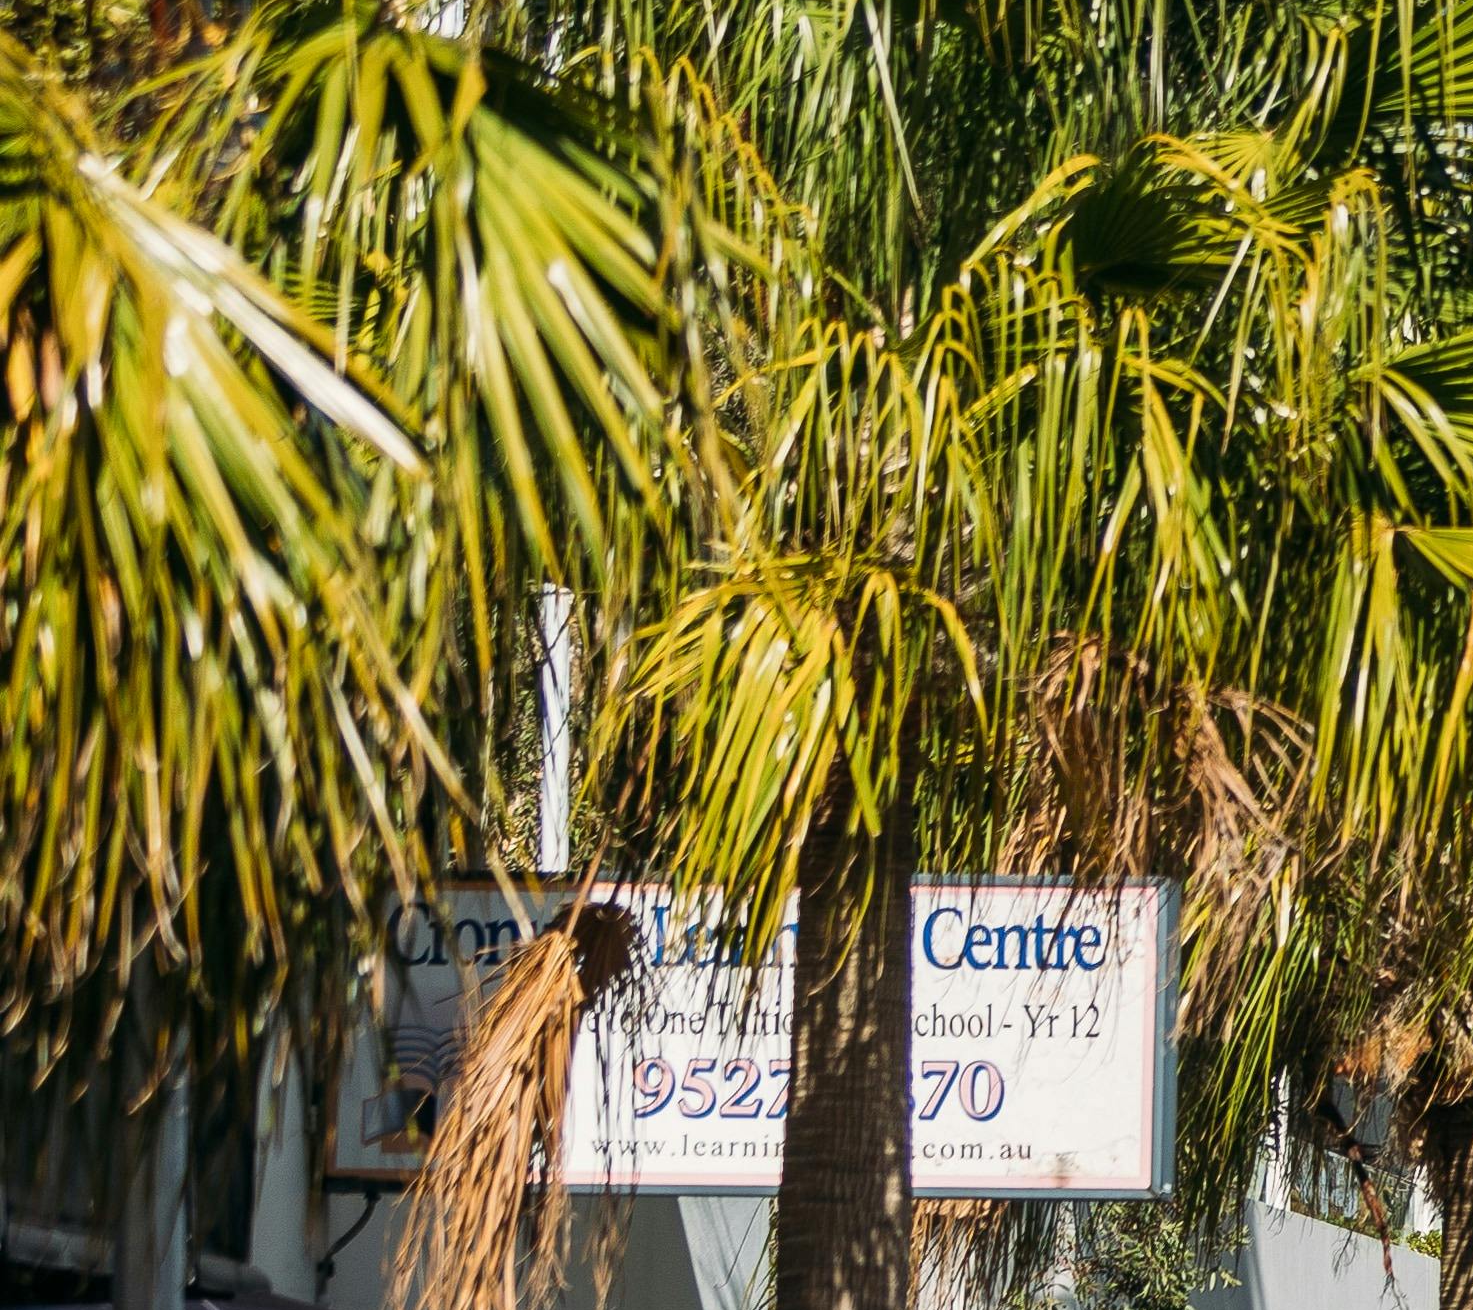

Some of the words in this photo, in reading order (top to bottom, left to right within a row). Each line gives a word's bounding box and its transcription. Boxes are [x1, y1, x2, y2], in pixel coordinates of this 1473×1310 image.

[922, 907, 1105, 971] Centre
[709, 1001, 793, 1036] Tuitio
[915, 1004, 992, 1038] chool
[1023, 1005, 1060, 1037] Yr
[1071, 1004, 1101, 1038] 12
[915, 1059, 1006, 1123] 70
